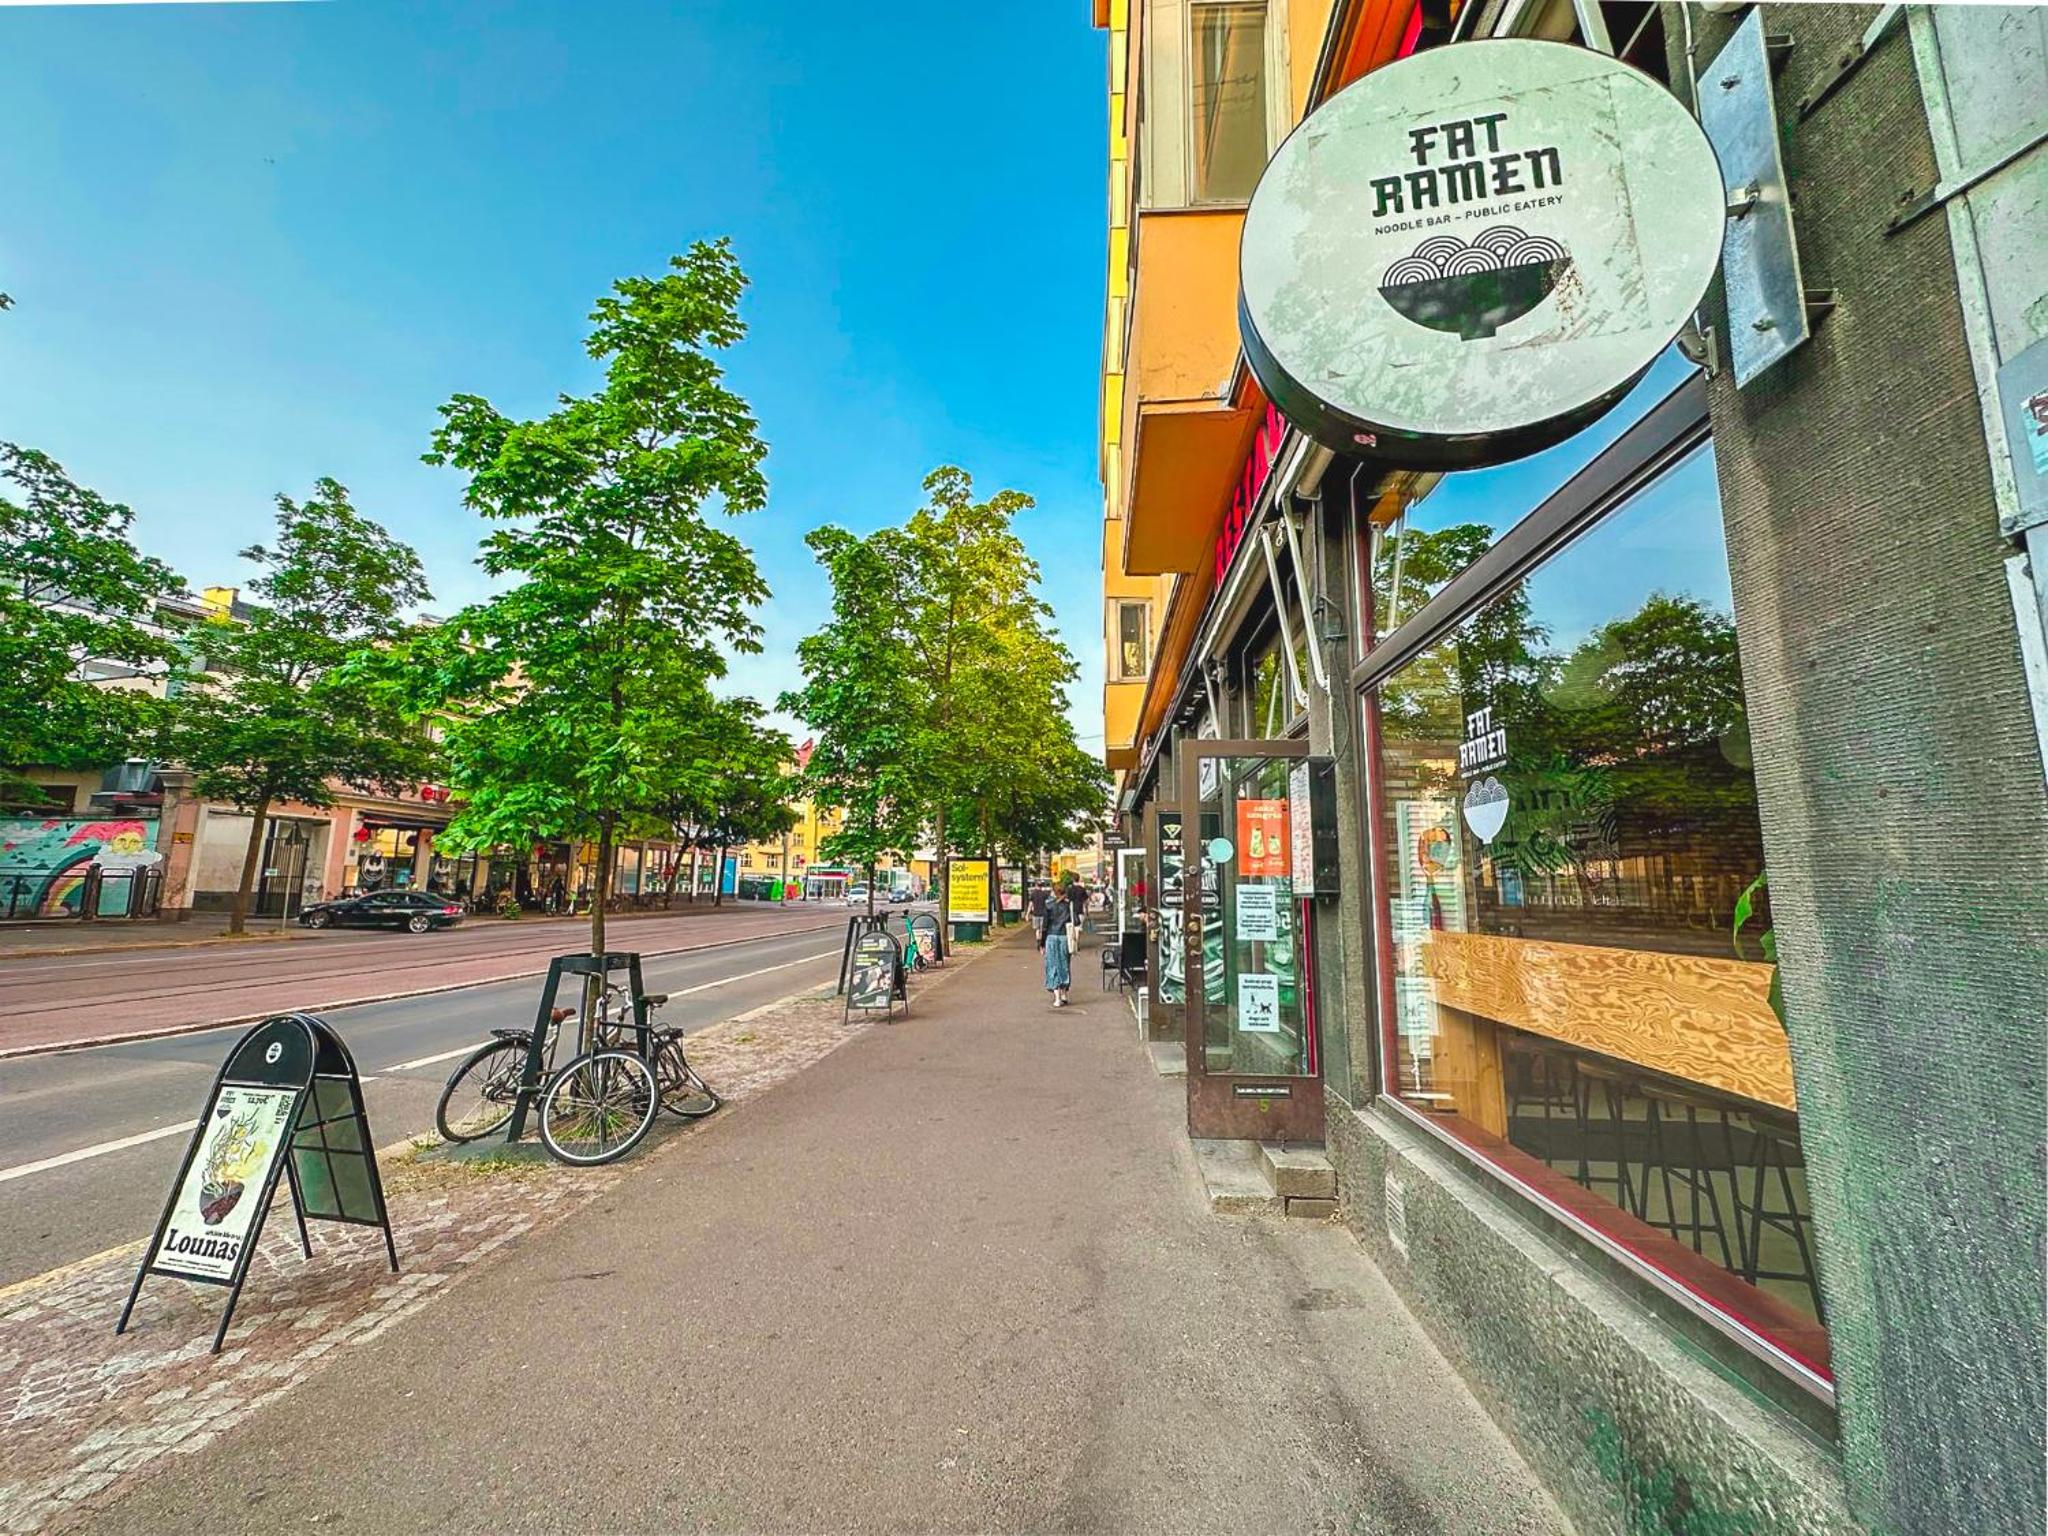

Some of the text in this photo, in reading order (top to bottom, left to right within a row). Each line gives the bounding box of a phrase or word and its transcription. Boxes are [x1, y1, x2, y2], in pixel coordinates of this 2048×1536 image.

[1408, 113, 1508, 166] FAT
[1369, 147, 1563, 218] RAMEN
[1375, 219, 1423, 236] NOODLE
[1427, 215, 1452, 228] BAR
[1465, 204, 1511, 220] PUBLIC
[1514, 195, 1564, 211] EATERY
[1466, 706, 1493, 738] FAT
[1459, 728, 1507, 768] RAMEN
[163, 1228, 240, 1261] Lounas
